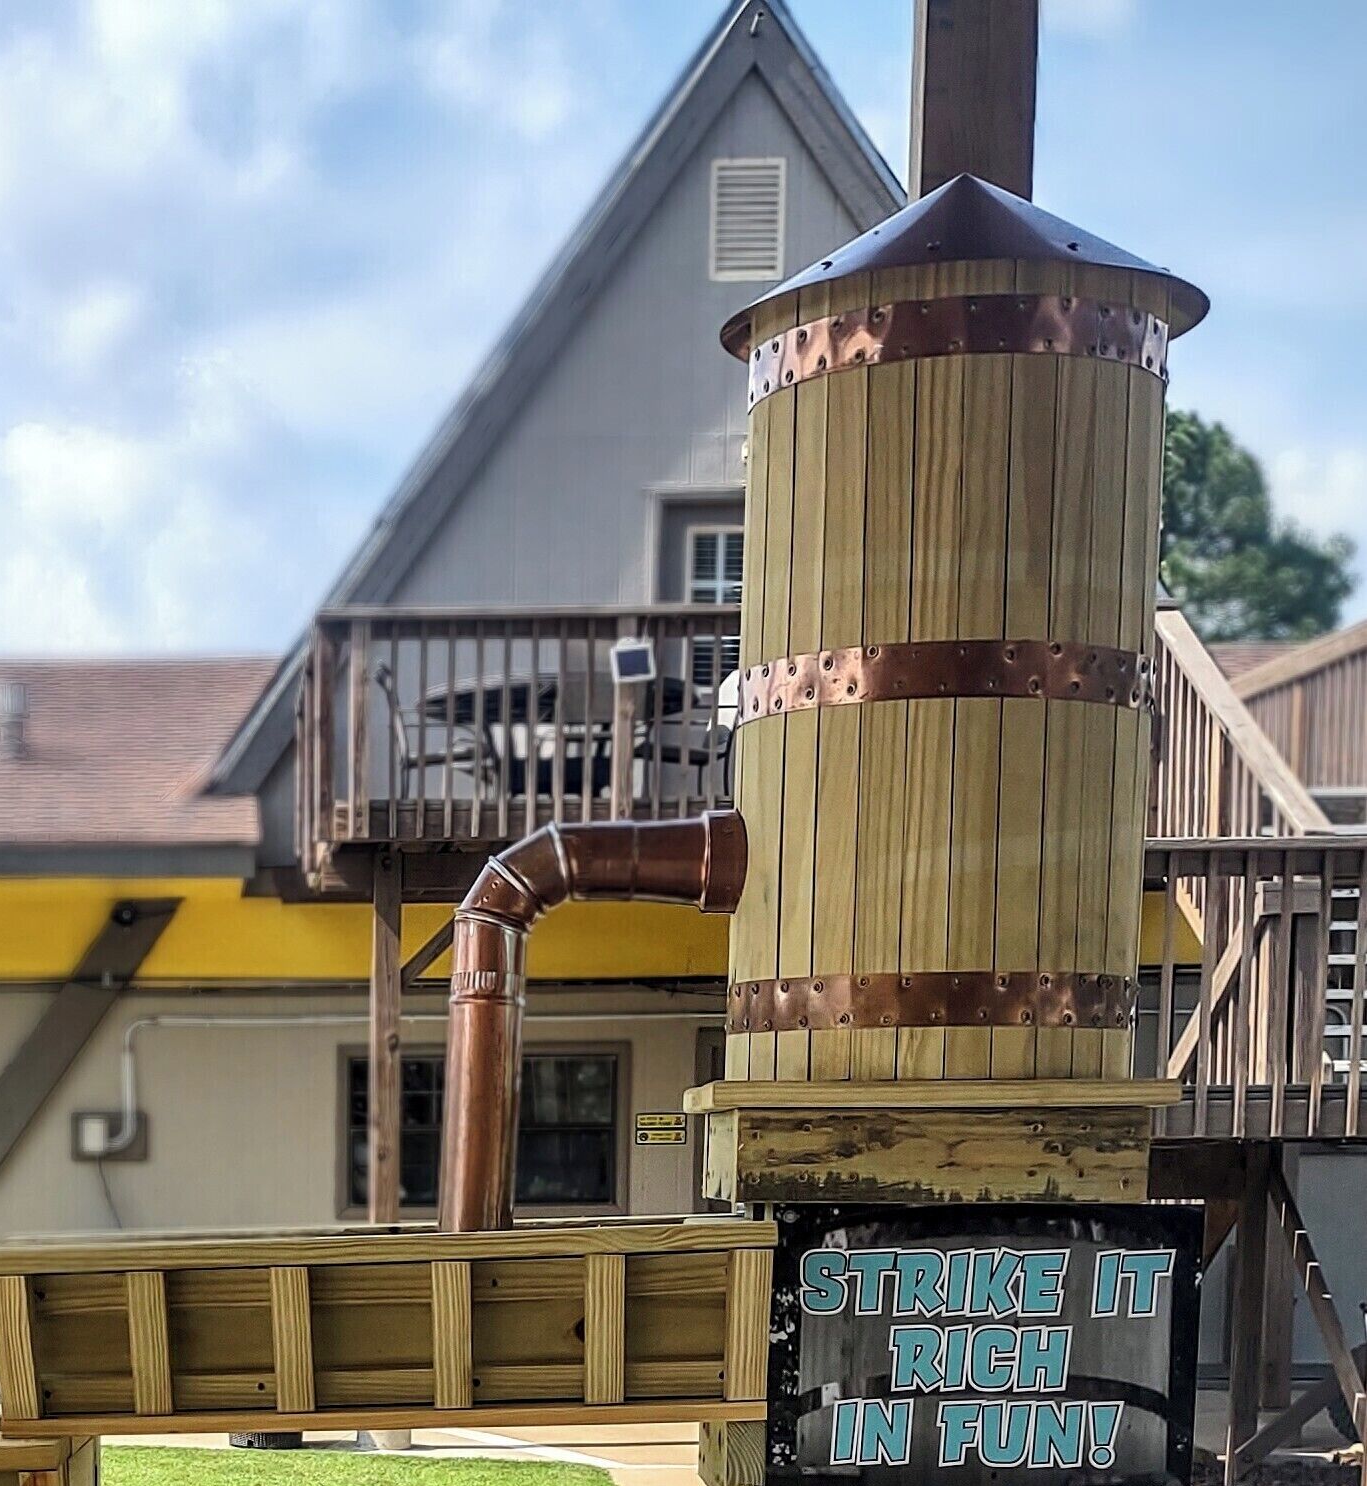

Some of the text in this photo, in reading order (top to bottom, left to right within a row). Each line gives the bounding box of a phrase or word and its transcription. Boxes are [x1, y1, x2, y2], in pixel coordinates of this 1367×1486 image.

[800, 1248, 1177, 1318] STRIKE IT
[890, 1324, 1074, 1394] RICH
[830, 1398, 1124, 1469] IN FUN!
